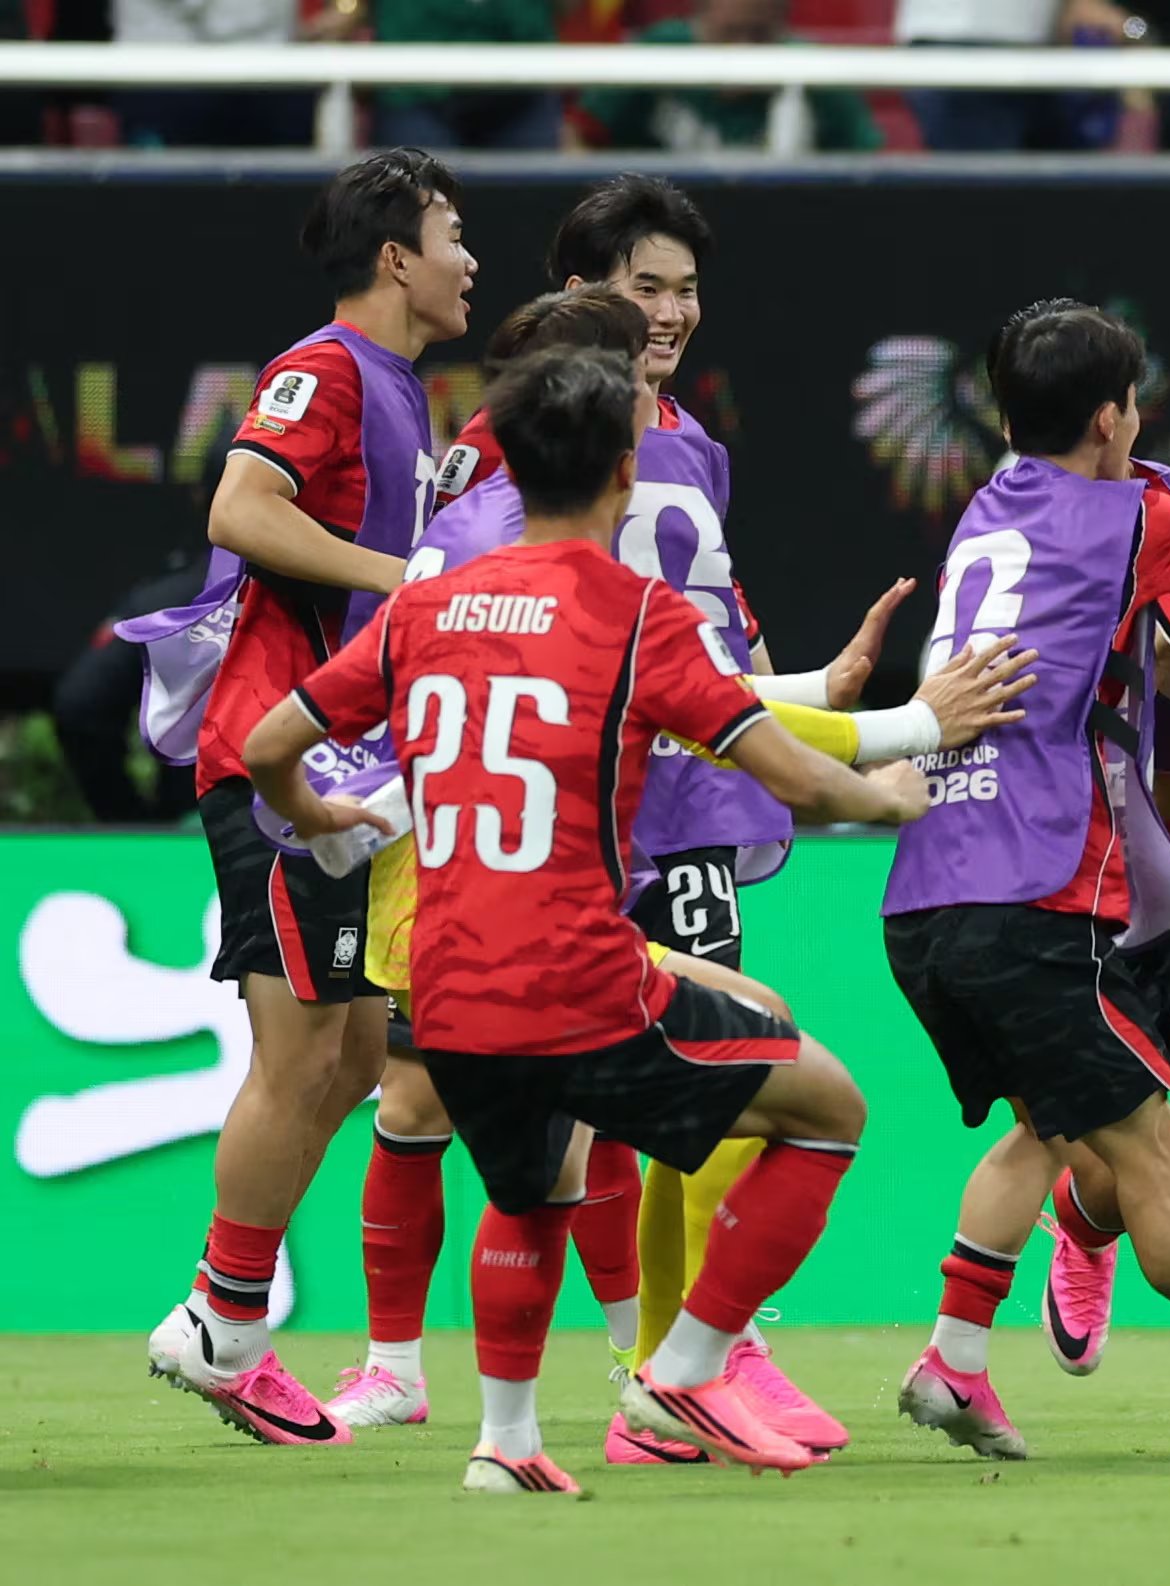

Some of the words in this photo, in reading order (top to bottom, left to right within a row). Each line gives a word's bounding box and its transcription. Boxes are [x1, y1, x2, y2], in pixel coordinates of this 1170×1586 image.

[436, 593, 558, 635] JISUNG
[406, 673, 574, 873] 25
[912, 749, 960, 773] ORLD
[961, 744, 1000, 766] CUP
[925, 768, 999, 808] 026
[667, 861, 740, 937] 24
